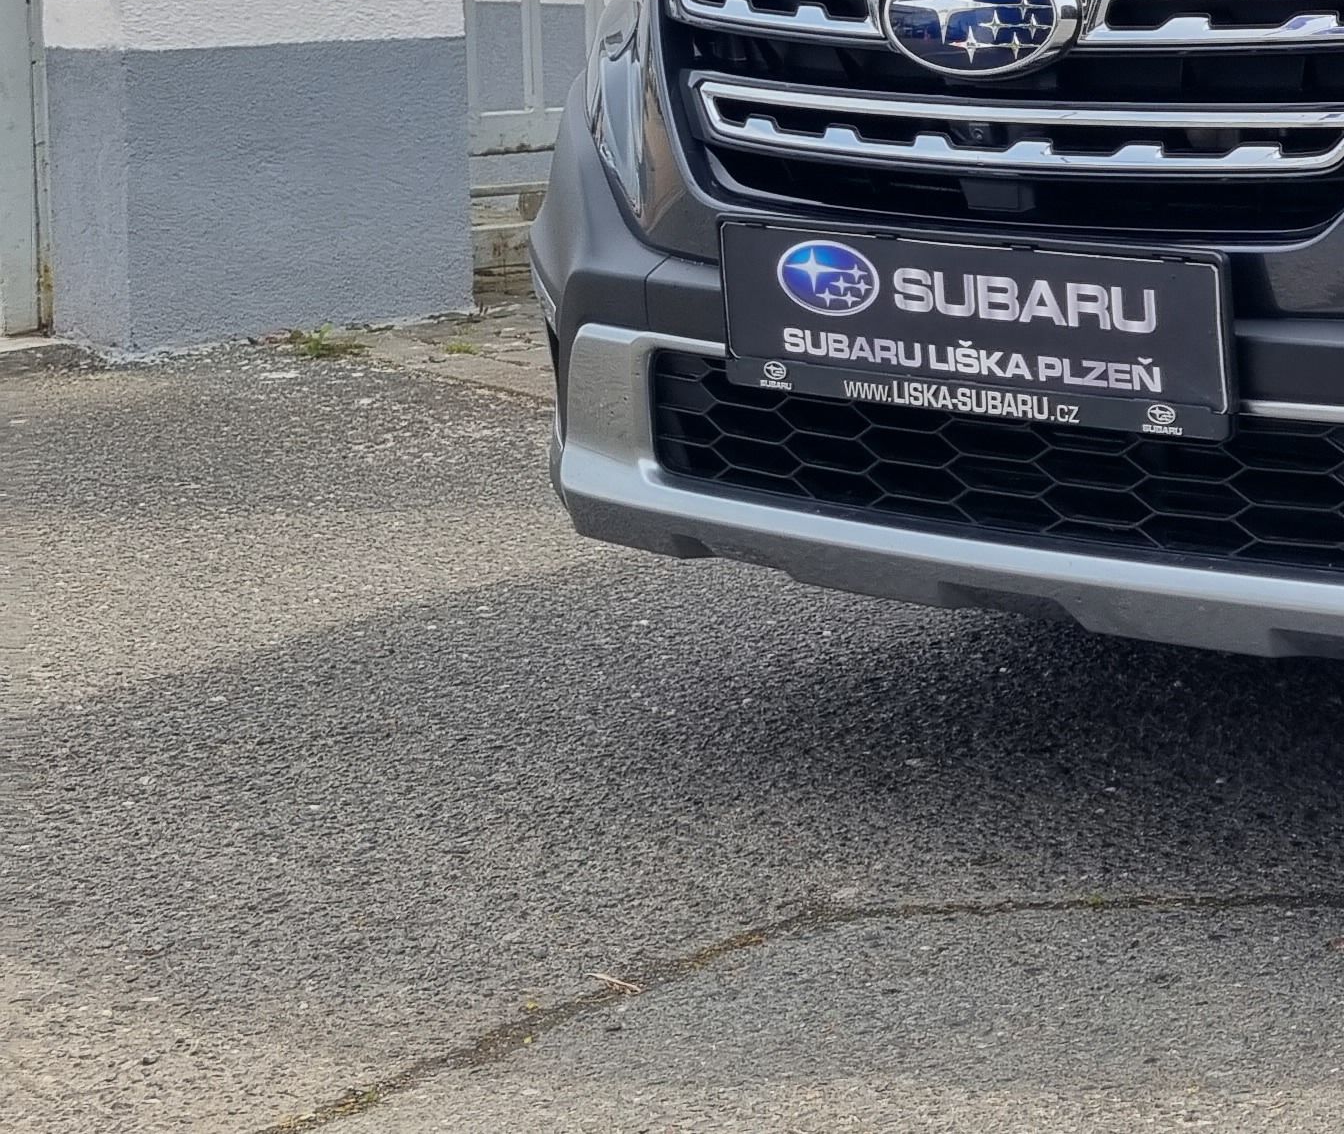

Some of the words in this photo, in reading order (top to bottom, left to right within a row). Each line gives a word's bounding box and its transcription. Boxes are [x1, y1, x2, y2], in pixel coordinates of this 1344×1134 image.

[892, 267, 1158, 334] SUBARU
[783, 327, 923, 368] SUBARU
[928, 339, 1032, 382] LIŠKA
[1038, 356, 1163, 394] PLZEŇ
[760, 379, 792, 390] SUBARU
[843, 379, 1080, 424] www.LISKA-SUBARU.cz
[1142, 424, 1183, 436] SUBARU
